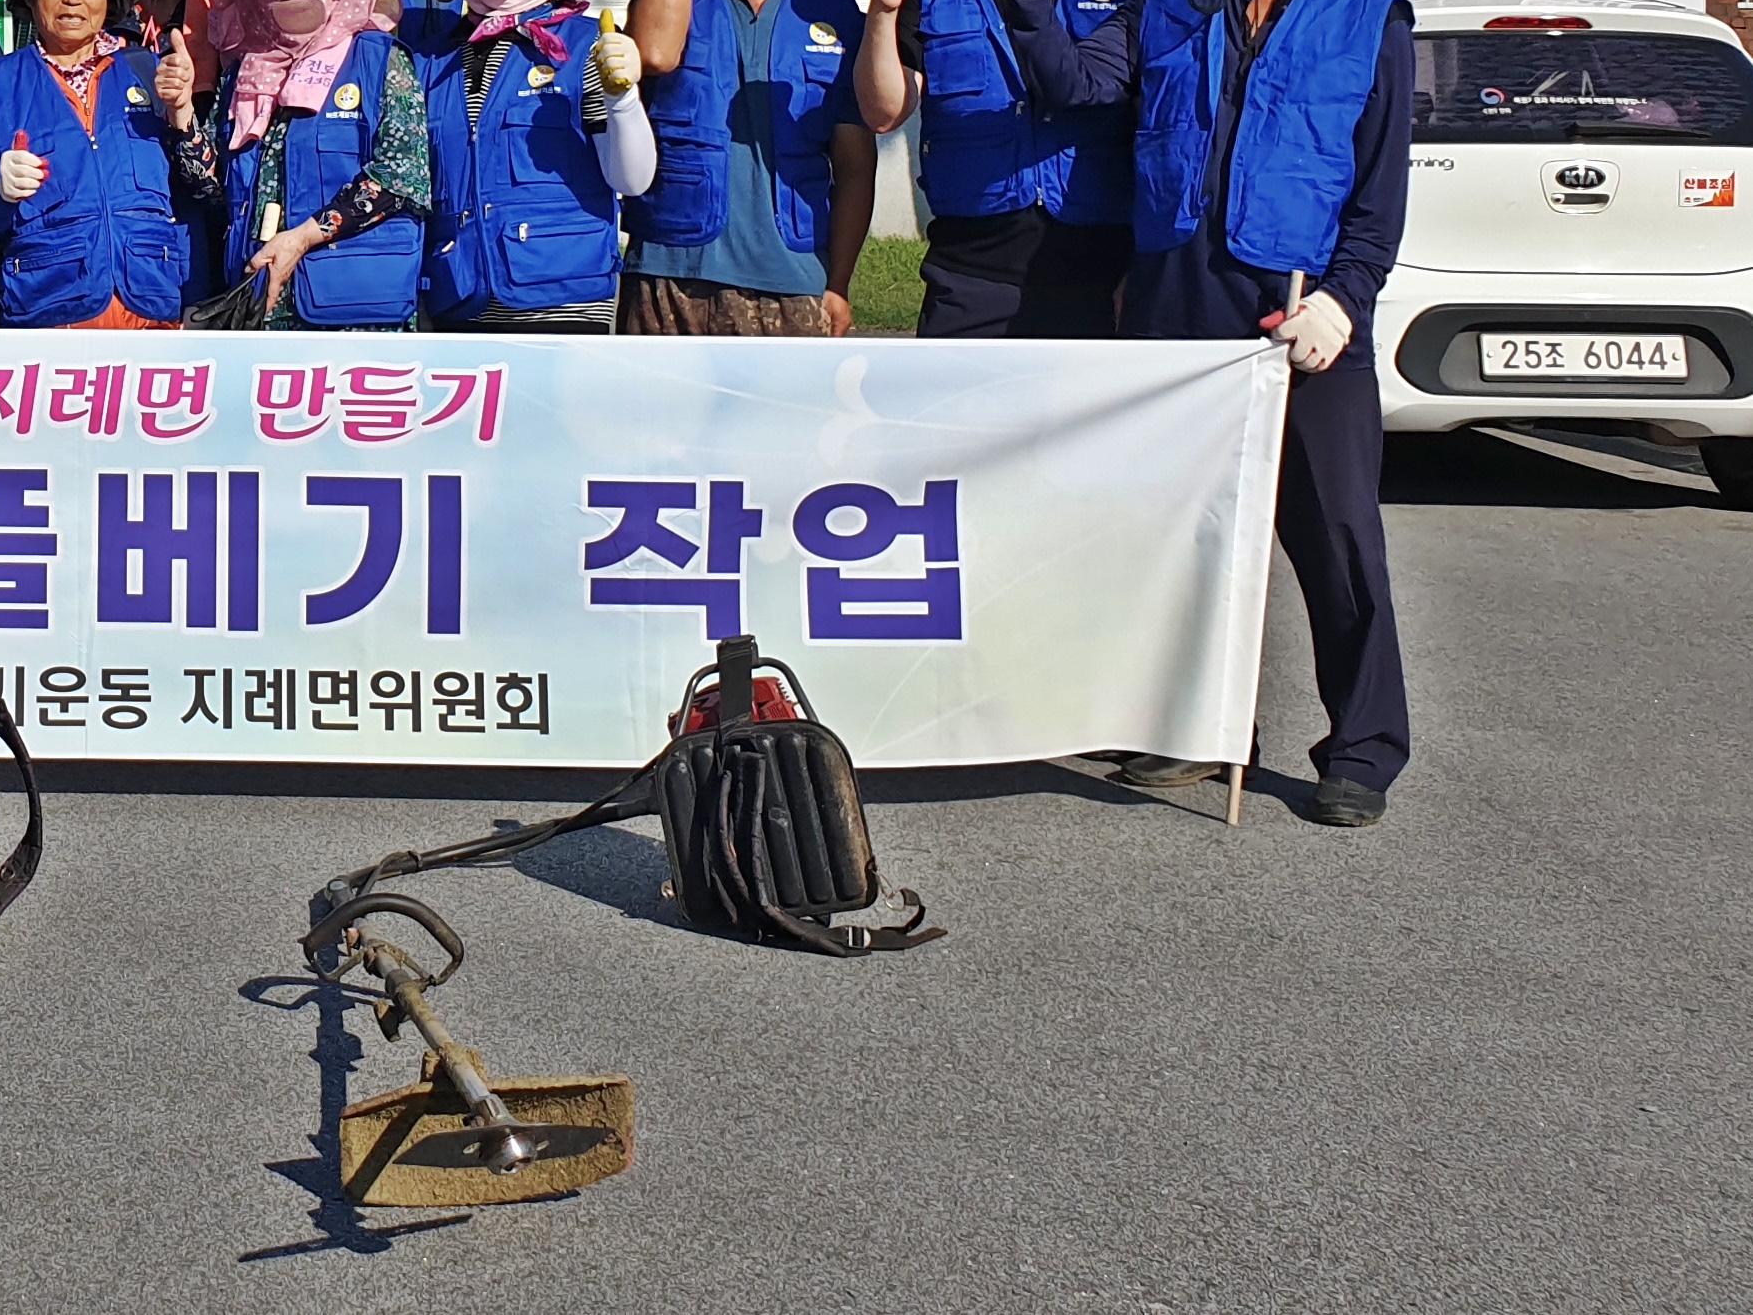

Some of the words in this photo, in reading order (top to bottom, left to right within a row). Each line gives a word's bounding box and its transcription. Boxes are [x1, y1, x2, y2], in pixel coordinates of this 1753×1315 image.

[1563, 168, 1600, 185] KIA
[1501, 340, 1565, 370] 25조
[1584, 341, 1668, 371] 6044
[257, 367, 504, 442] 만들기
[584, 480, 962, 641] 작업
[181, 668, 549, 735] 지례면위원회
